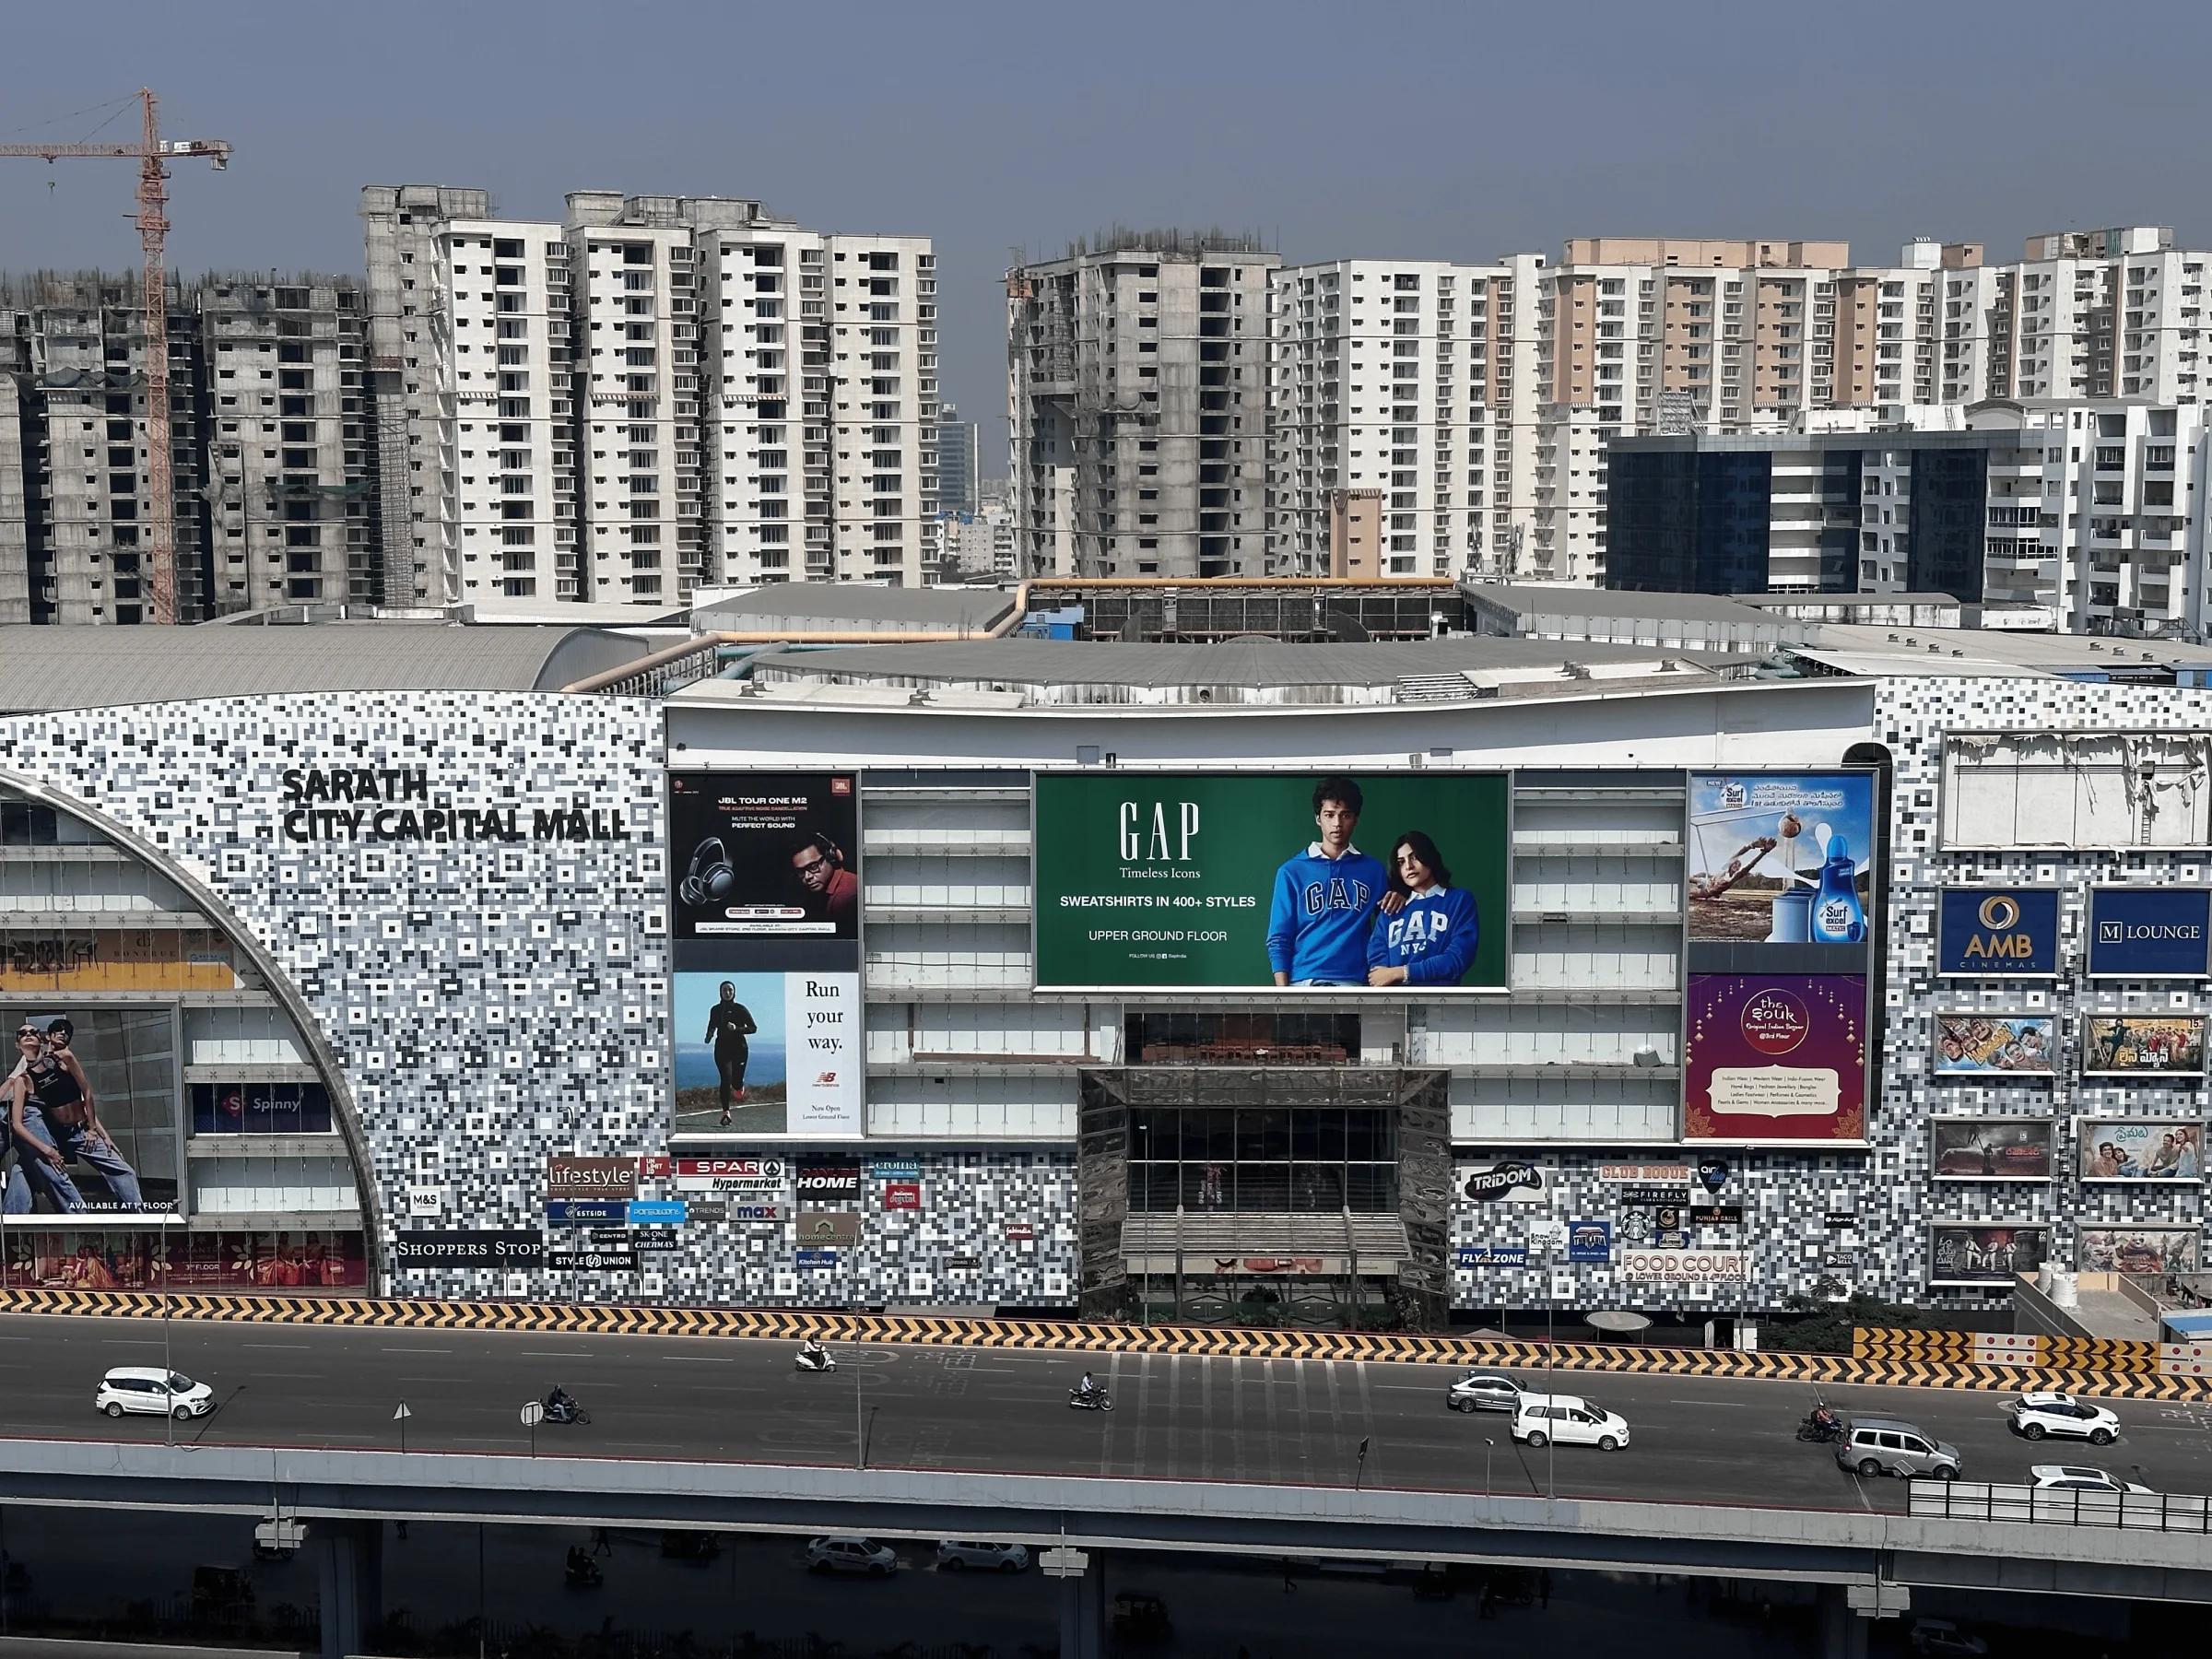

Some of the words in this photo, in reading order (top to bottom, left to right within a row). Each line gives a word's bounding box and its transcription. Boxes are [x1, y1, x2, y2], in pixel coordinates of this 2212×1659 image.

[282, 769, 428, 801] SARATH
[284, 809, 365, 841] CITY
[372, 809, 526, 841] CAPITAL
[533, 808, 631, 841] MALL
[1120, 801, 1199, 861] GAP
[1119, 867, 1168, 878] Timeless
[1171, 867, 1201, 878] Icons
[1060, 896, 1153, 907] SWEATSHIRTS
[1156, 896, 1170, 907] IN
[1172, 896, 1203, 908] 400+
[1206, 896, 1256, 908] STYLES
[1305, 877, 1371, 916] GAP
[1388, 910, 1448, 948] GAP
[2103, 926, 2120, 939] M
[2127, 925, 2201, 939] LOUNGE
[1088, 930, 1129, 941] UPPER
[1131, 930, 1184, 942] GROUND
[1187, 931, 1228, 942] FLOOR
[1400, 942, 1428, 956] NYC
[1964, 934, 2033, 959] AMB
[806, 981, 840, 997] Run
[1761, 995, 1783, 1008] the
[807, 1011, 843, 1029] your
[1746, 1022, 1767, 1031] Original
[1785, 1022, 1805, 1031] Bazaar
[2189, 1018, 2199, 1028] 15
[807, 1038, 842, 1054] way.
[253, 1098, 300, 1112] Spinny
[826, 1104, 841, 1113] Open
[697, 1161, 759, 1173] SPAR
[876, 1160, 918, 1170] croma
[1603, 1165, 1639, 1178] CLUB
[1700, 1166, 1717, 1174] air
[549, 1164, 630, 1187] lifestyle
[712, 1177, 782, 1191] Hypermarket
[796, 1177, 858, 1189] HOME
[414, 1194, 437, 1206] M&S
[889, 1192, 916, 1205] digital
[736, 1206, 777, 1218] max
[798, 1232, 855, 1241] homecentre
[1006, 1226, 1032, 1236] fabindia
[2039, 1230, 2046, 1239] 22
[398, 1241, 488, 1256] SHOPPERS
[495, 1241, 541, 1256] STOP
[603, 1256, 631, 1265] UNION
[1462, 1254, 1482, 1263] FLY
[1493, 1254, 1525, 1264] ZONE
[1624, 1254, 1678, 1271] FOOD
[1682, 1255, 1749, 1273] COURT
[1625, 1273, 1634, 1281] @
[1635, 1273, 1663, 1281] LOWER
[1664, 1273, 1700, 1281] GROUND
[1701, 1273, 1709, 1281] &
[1720, 1273, 1747, 1282] FLOOR
